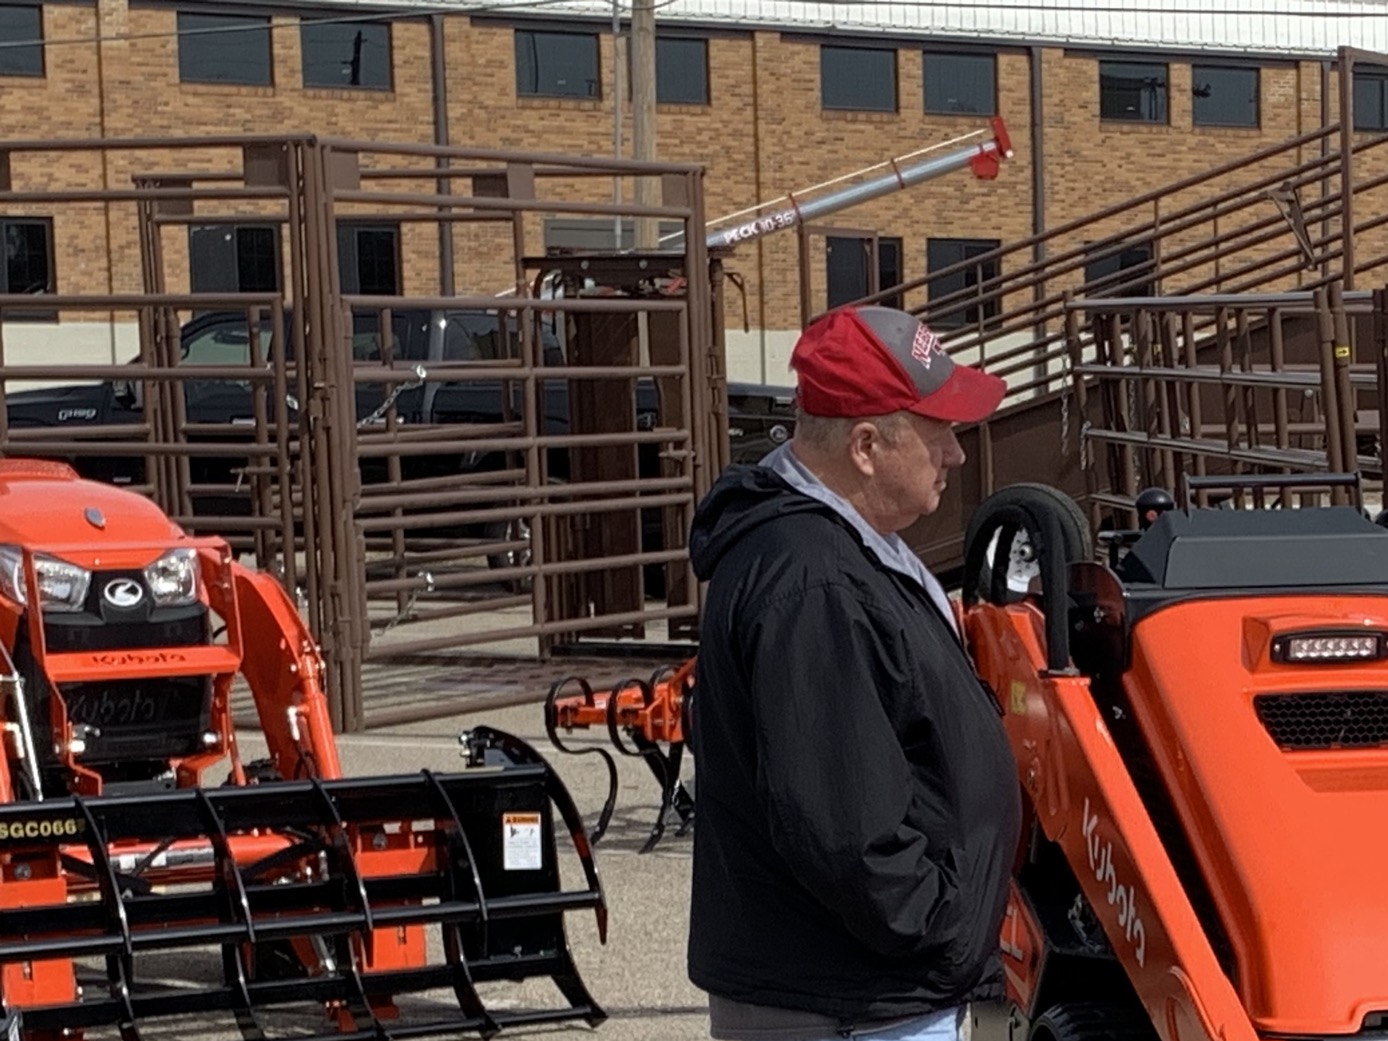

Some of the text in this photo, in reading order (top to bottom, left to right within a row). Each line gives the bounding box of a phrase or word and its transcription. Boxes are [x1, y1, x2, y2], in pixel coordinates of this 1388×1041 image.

[724, 221, 760, 244] PECK
[91, 653, 186, 665] Kubota
[1082, 797, 1146, 968] Kubota
